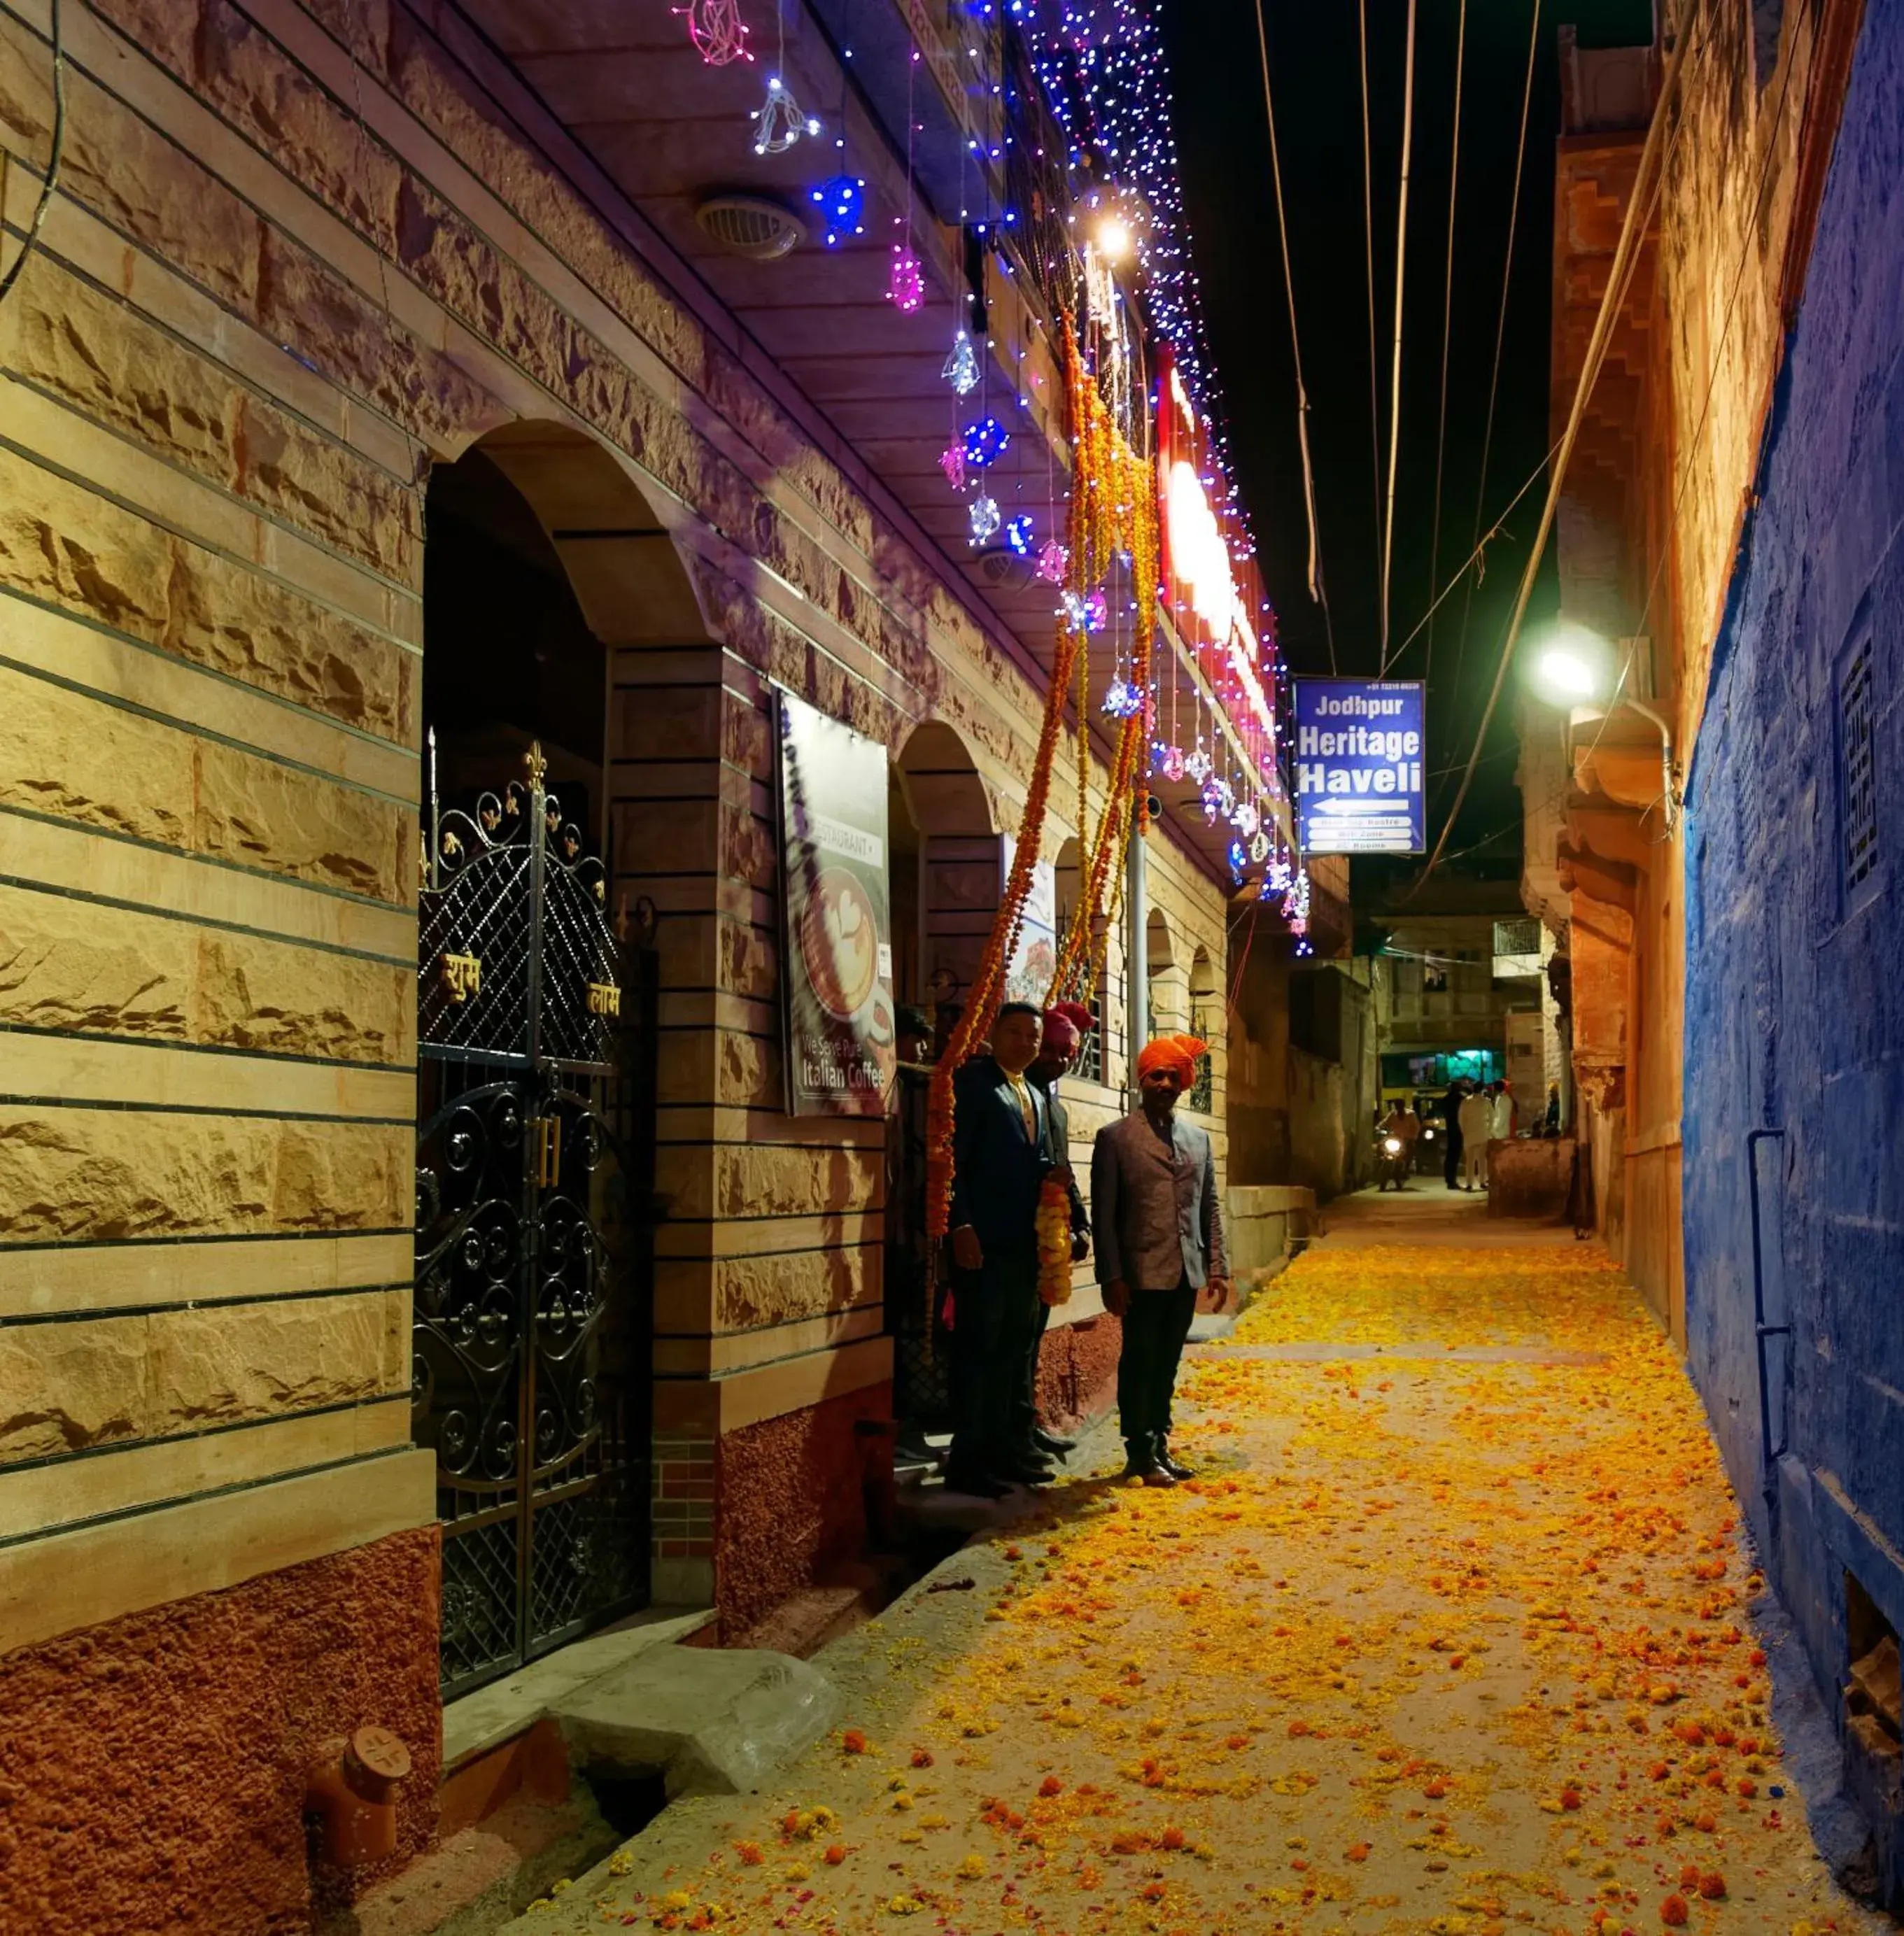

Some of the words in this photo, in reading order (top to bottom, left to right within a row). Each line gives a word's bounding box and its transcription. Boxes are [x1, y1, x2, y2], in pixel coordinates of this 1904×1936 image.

[1315, 695, 1404, 719] Jodhpur
[1299, 725, 1420, 762] Heritage
[1299, 762, 1420, 793] Haveli
[442, 952, 481, 1001] शुभ
[588, 982, 621, 1017] लाभ
[802, 1034, 817, 1054] We
[803, 1057, 845, 1089] Italian
[847, 1060, 885, 1089] Coffee
